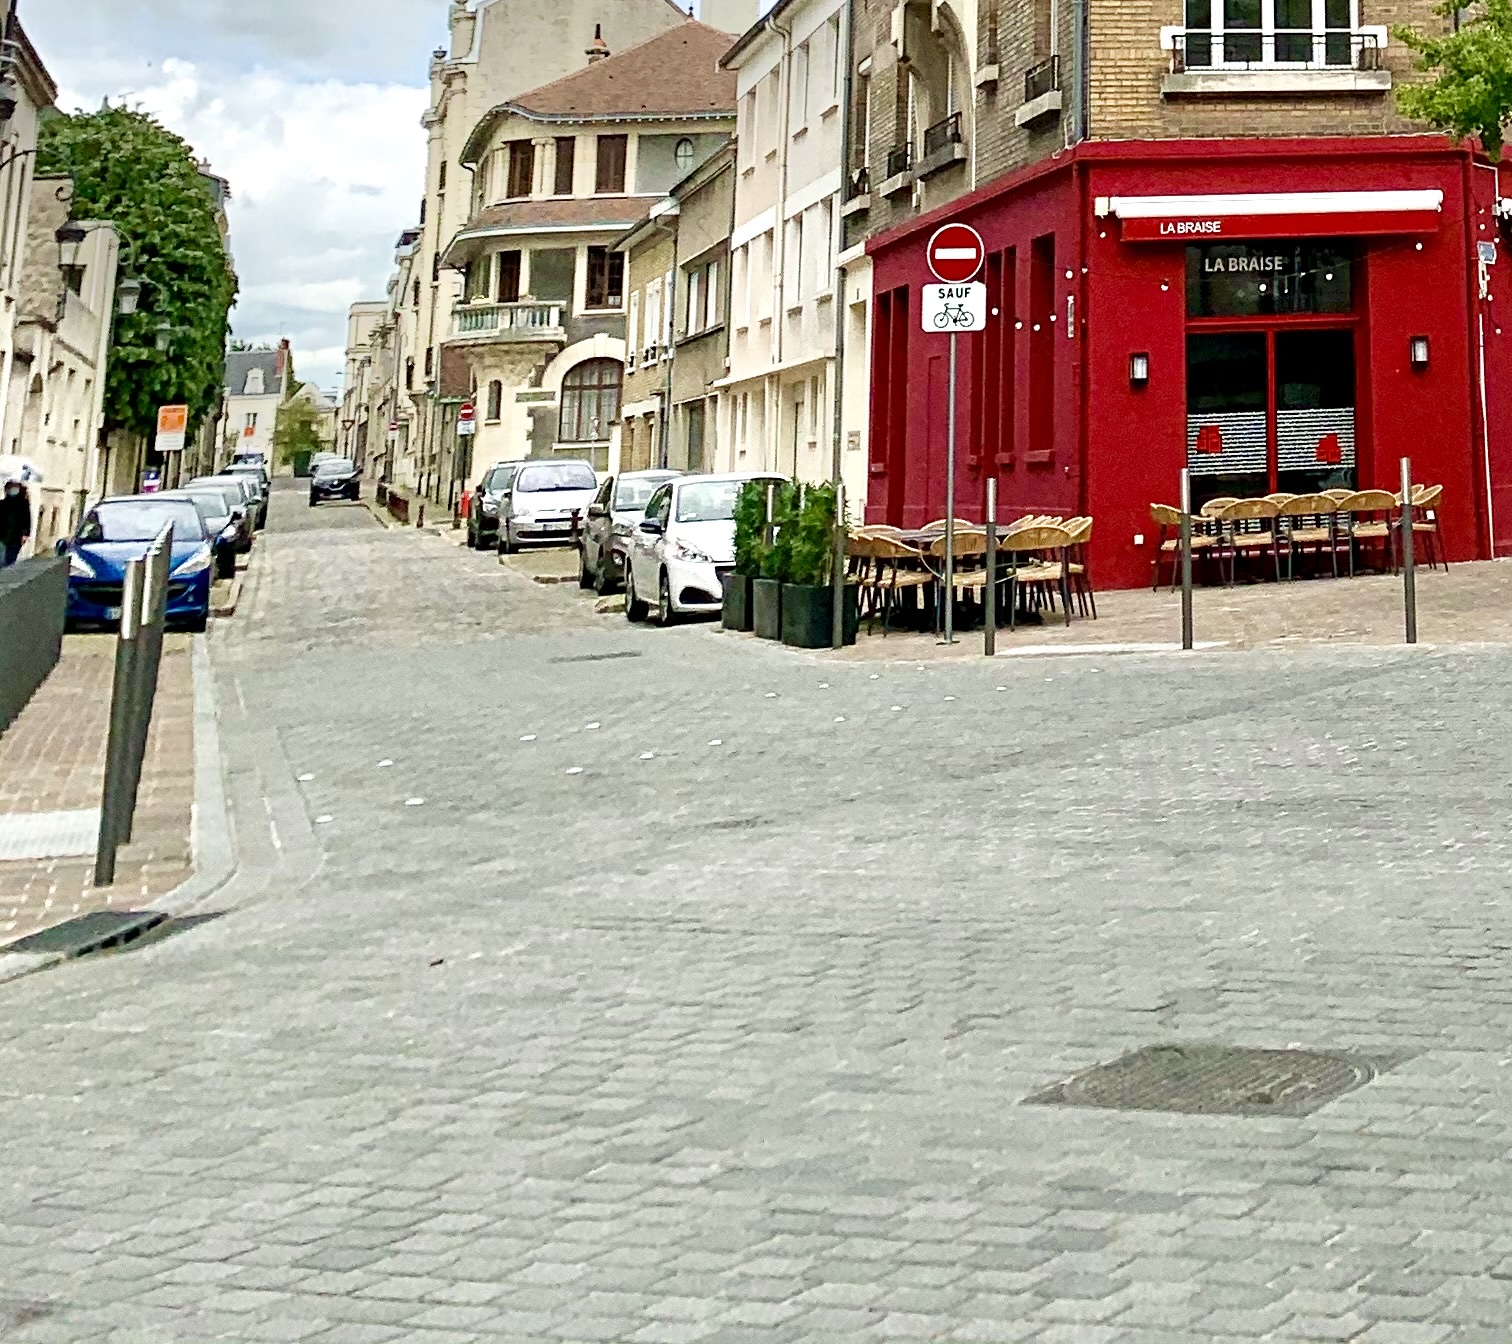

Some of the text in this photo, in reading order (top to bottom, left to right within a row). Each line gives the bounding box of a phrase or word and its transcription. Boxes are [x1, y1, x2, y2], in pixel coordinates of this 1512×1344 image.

[1160, 221, 1222, 235] LA BRAISE
[1204, 256, 1283, 272] LA BRAISE
[938, 287, 971, 299] SAUF
